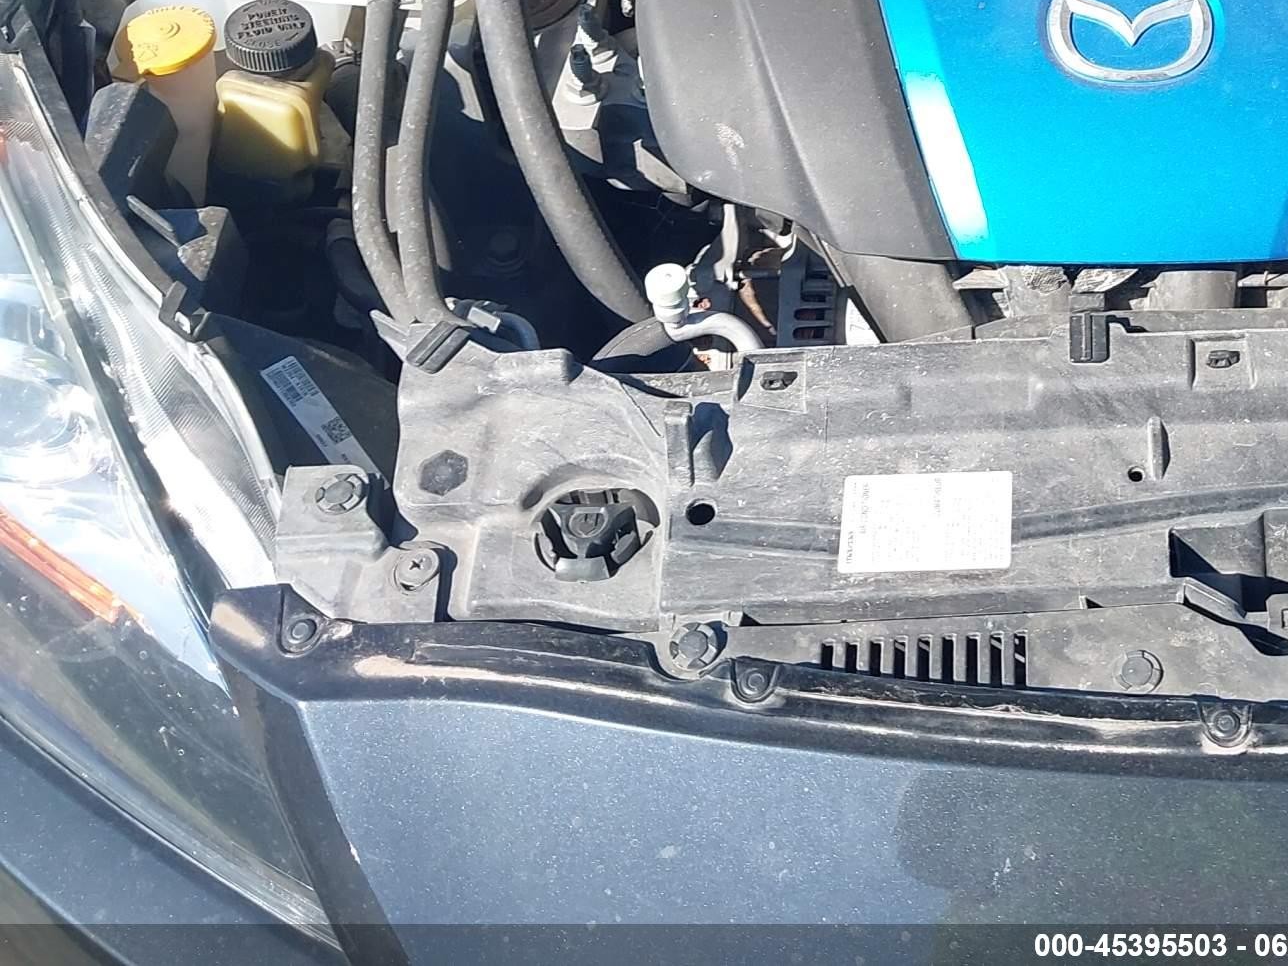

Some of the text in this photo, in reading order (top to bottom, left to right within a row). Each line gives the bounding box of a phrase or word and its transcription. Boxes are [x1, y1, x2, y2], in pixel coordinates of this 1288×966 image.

[240, 14, 301, 30] STEERING
[247, 8, 288, 21] POWER
[237, 20, 307, 40] FLUID ONLY
